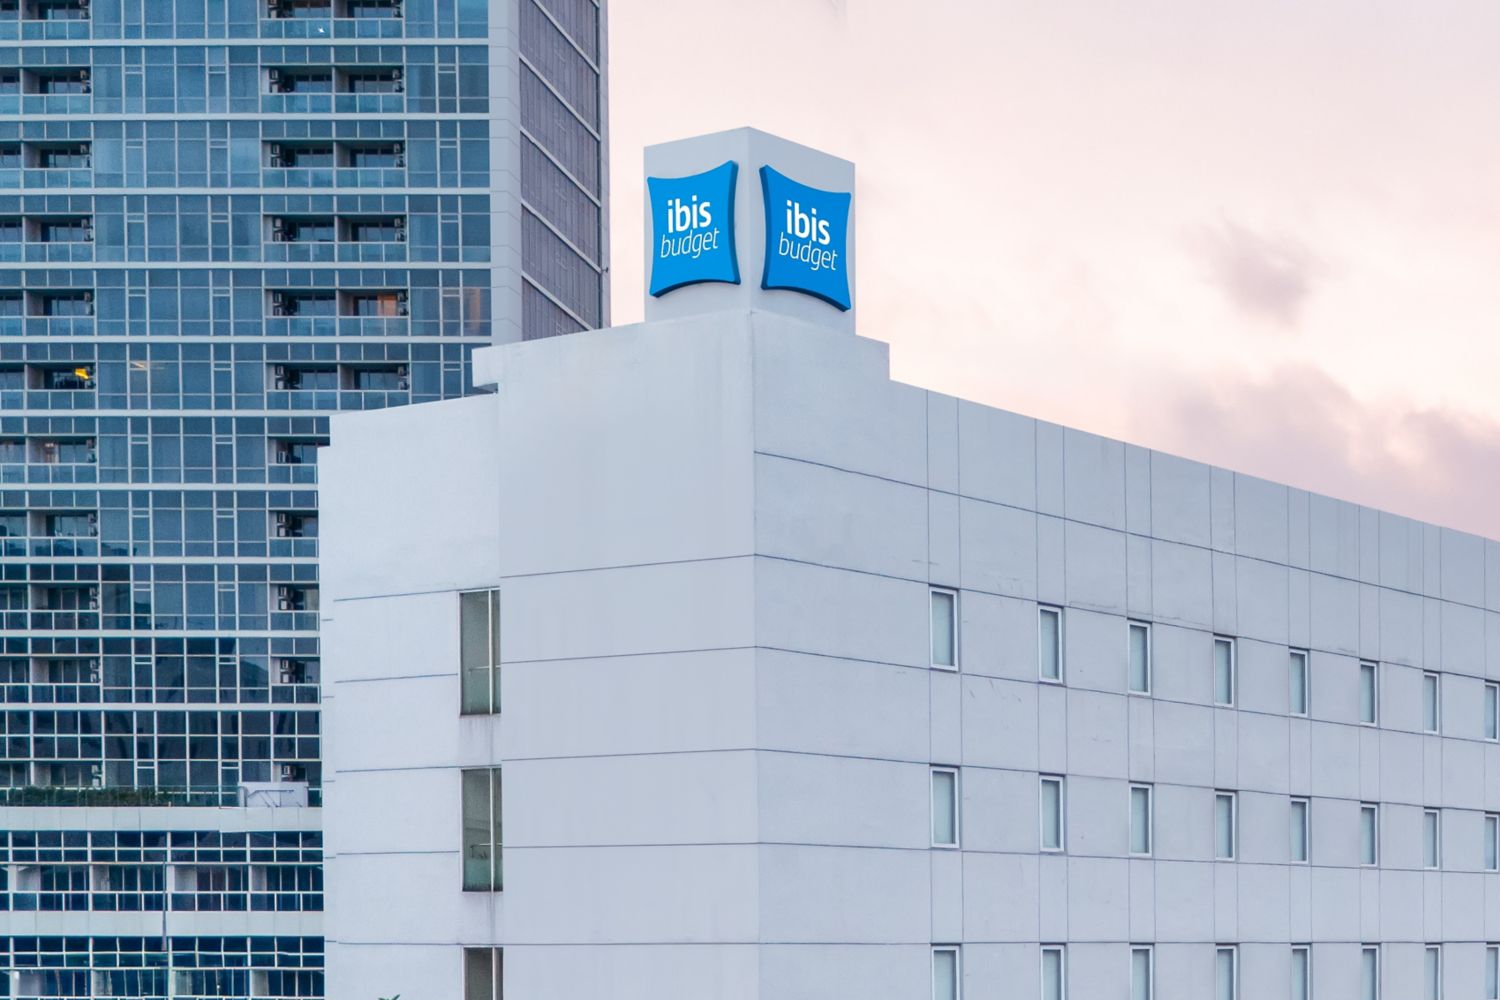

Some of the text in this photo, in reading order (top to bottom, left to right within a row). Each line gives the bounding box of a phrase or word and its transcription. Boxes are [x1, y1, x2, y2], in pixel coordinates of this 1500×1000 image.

[667, 195, 712, 234] ibis
[786, 199, 831, 246] ibis
[660, 228, 720, 259] budget
[778, 231, 838, 271] budget
